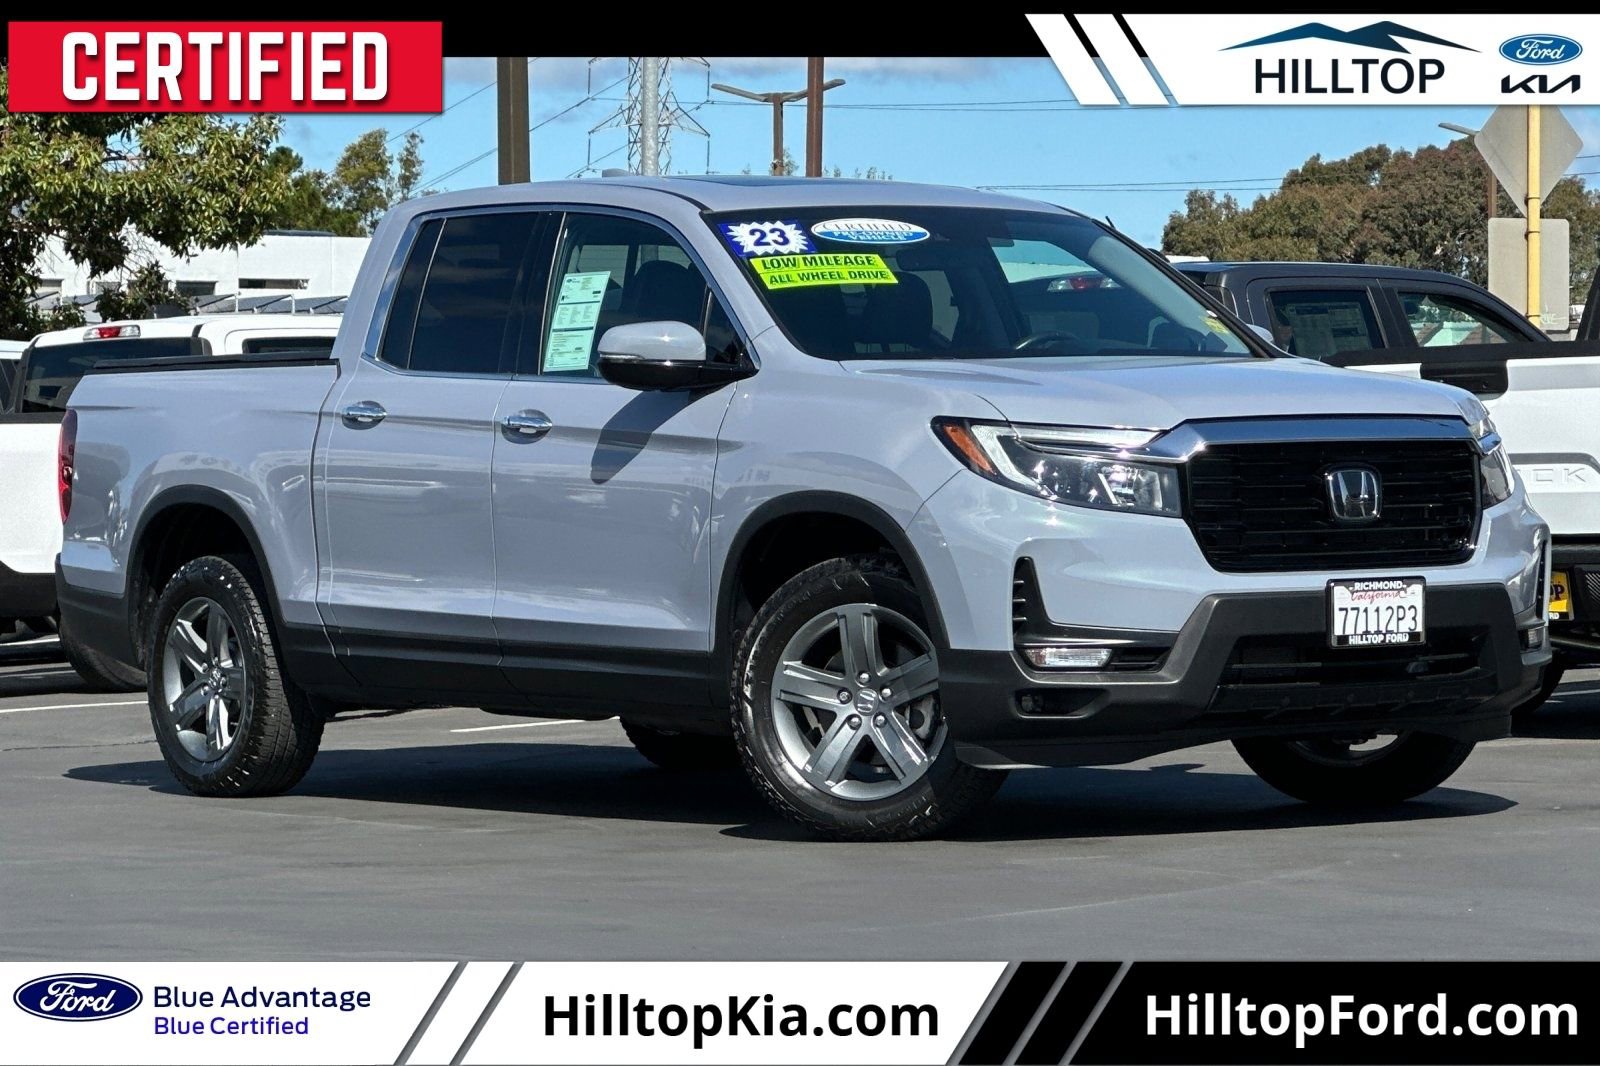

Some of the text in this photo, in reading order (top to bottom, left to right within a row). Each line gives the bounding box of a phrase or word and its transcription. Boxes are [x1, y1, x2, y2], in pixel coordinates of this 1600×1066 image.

[749, 228, 790, 246] 23
[762, 255, 876, 270] LOW MILEAGE
[769, 269, 889, 285] ALL WHEEL DRIVE
[1354, 580, 1404, 591] RICHMOND
[1338, 604, 1418, 635] 77112P3
[1348, 633, 1410, 645] HILLTOP FORD
